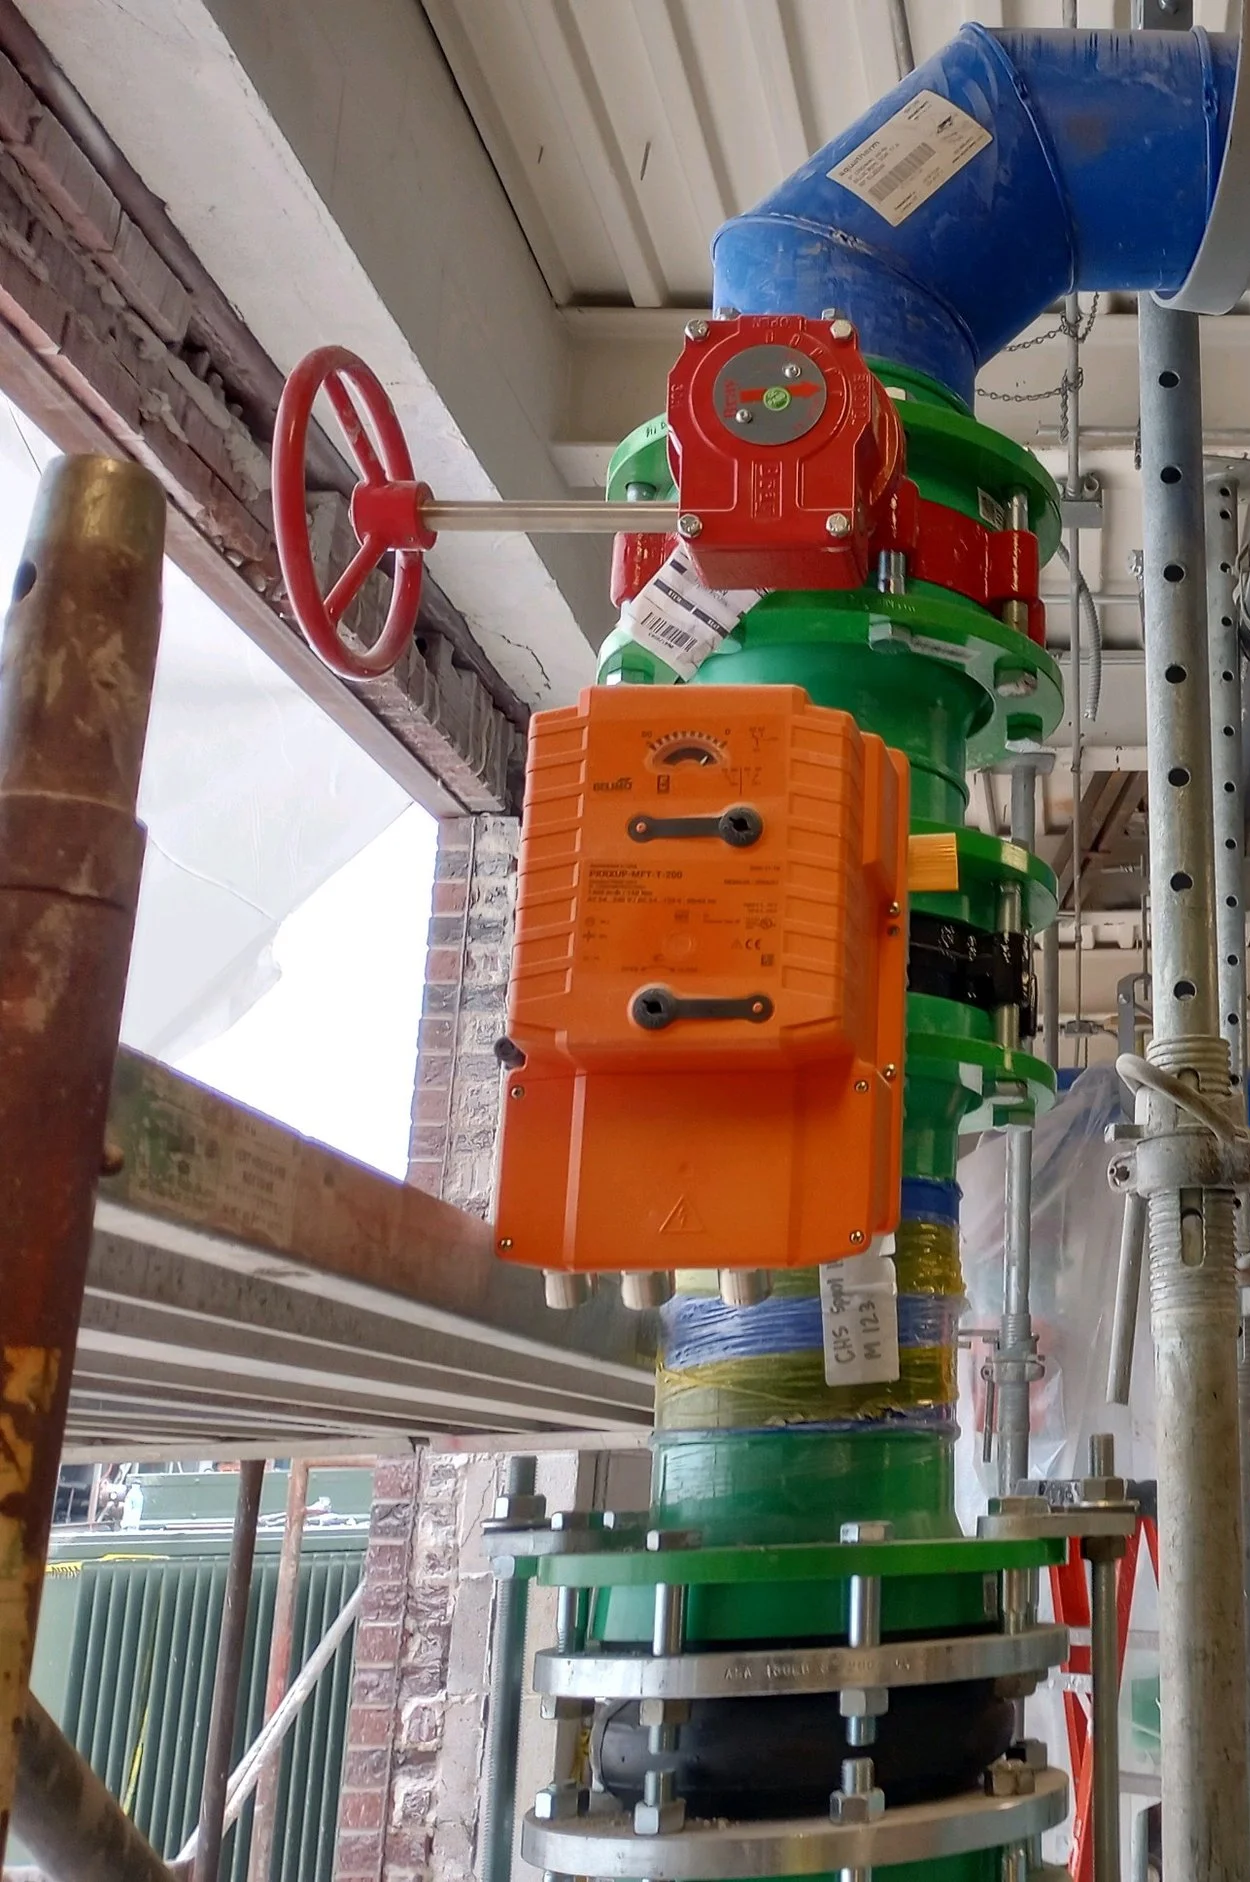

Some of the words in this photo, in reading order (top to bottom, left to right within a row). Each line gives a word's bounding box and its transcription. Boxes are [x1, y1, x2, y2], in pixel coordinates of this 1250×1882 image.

[858, 1300, 880, 1334] 123
[832, 1325, 856, 1364] CHS
[863, 1341, 882, 1360] M
